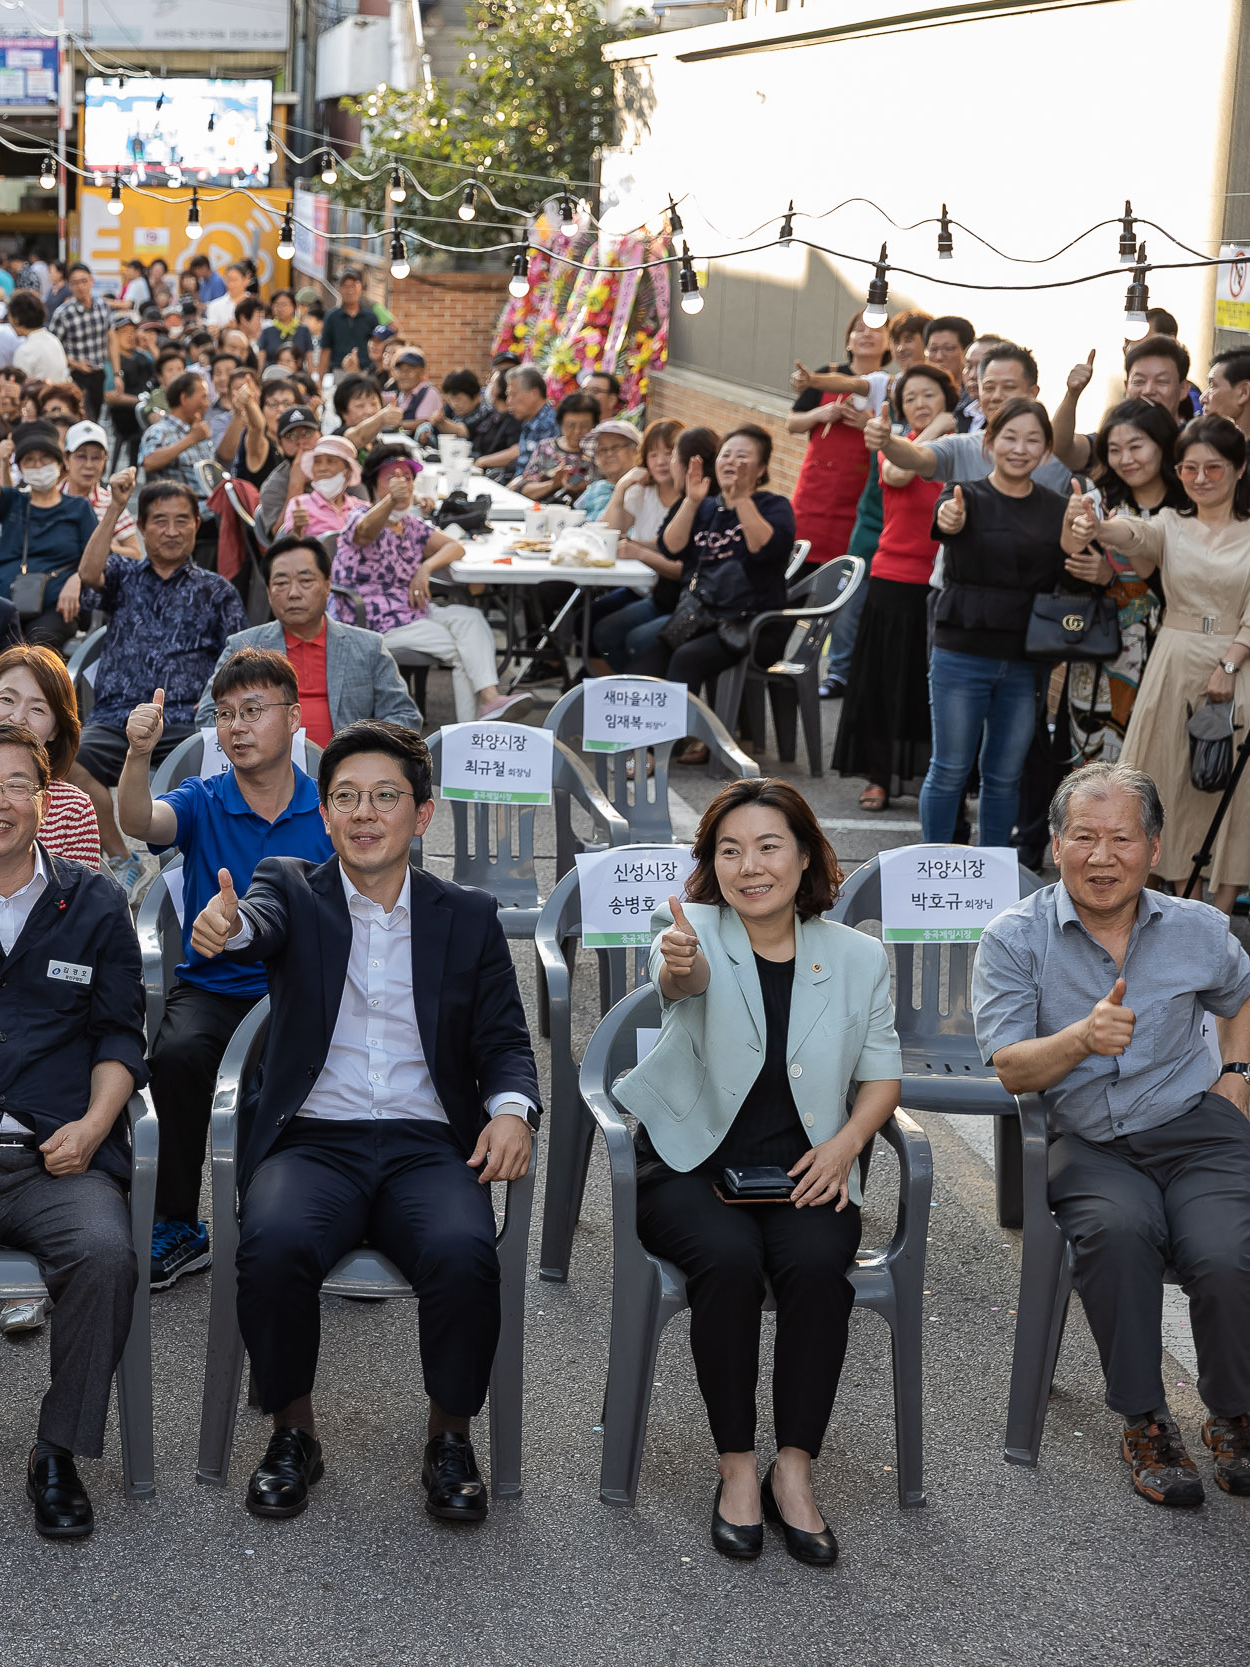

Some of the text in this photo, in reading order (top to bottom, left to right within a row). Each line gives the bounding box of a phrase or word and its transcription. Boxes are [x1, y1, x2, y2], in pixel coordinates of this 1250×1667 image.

[604, 690, 667, 707] 새마을시장
[605, 714, 643, 730] 임재복
[471, 733, 527, 751] 화양시장
[464, 760, 531, 778] 최규철 회장님
[614, 862, 678, 882] 신성시장
[917, 859, 985, 878] 자양시장
[608, 896, 656, 915] 송병호
[911, 892, 993, 911] 박호규 회장님
[923, 929, 972, 940] 중곡제일시장
